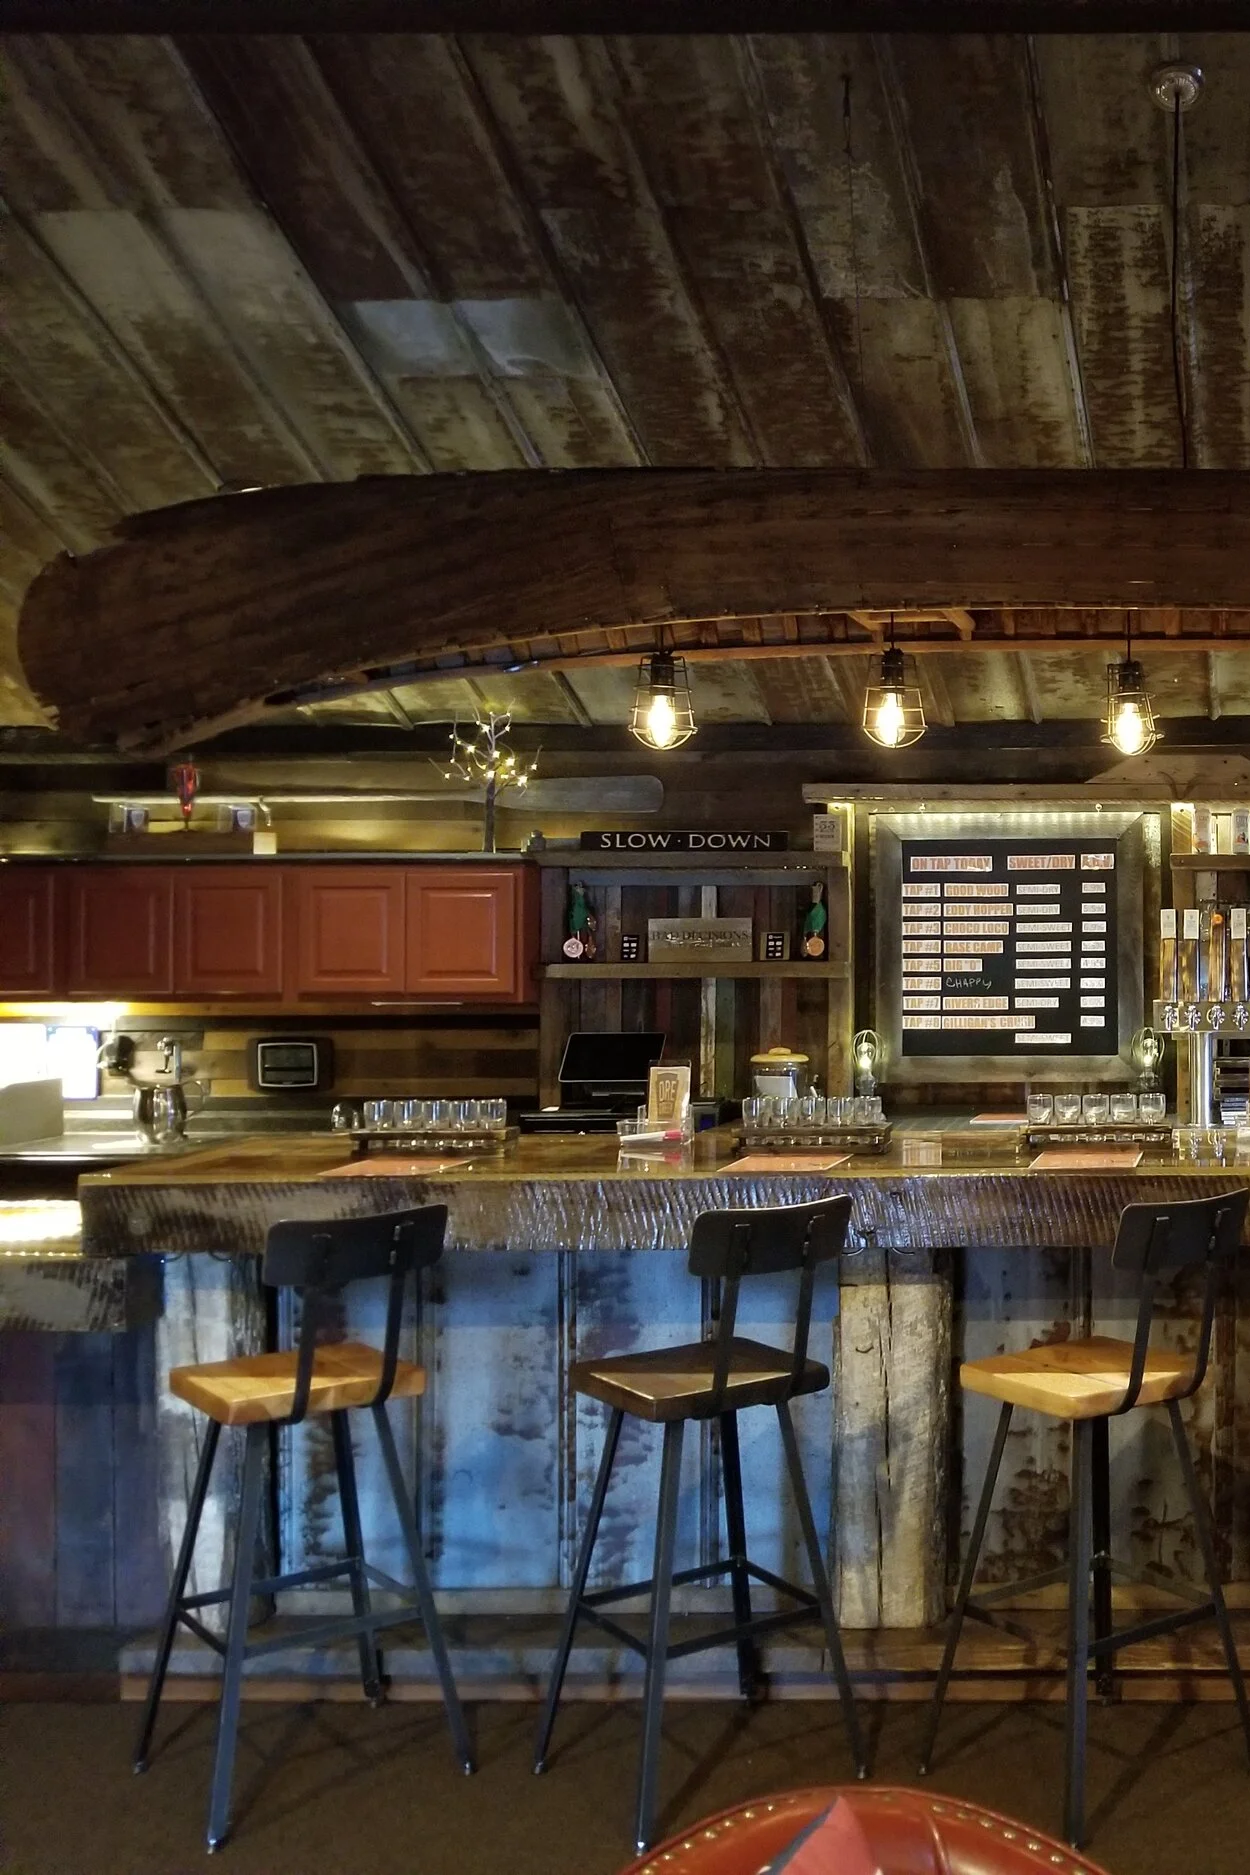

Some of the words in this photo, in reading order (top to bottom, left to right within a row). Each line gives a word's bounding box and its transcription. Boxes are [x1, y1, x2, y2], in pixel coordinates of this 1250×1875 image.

[600, 833, 671, 848] SLOW
[689, 834, 771, 848] DOWN
[912, 858, 928, 870] ON
[931, 857, 951, 869] TAP
[955, 857, 990, 870] TODAY
[1009, 856, 1075, 868] SWEET/DRY
[904, 885, 922, 895] TAP
[925, 885, 940, 895] #1
[946, 885, 973, 895] GOOD
[976, 885, 1007, 895] WOOD
[904, 905, 922, 915] TAP
[925, 905, 940, 915] #2
[946, 905, 972, 915] EDDY
[974, 904, 1012, 915] HOPPER
[904, 923, 922, 933] TAP
[925, 923, 940, 933] #3
[945, 923, 979, 933] CHOCO
[983, 923, 1008, 933] LOCO
[904, 941, 922, 952] TAP
[925, 941, 940, 952] #4
[946, 942, 972, 952] BASE
[973, 942, 1002, 952] CAMP
[904, 960, 922, 970] TAP
[925, 960, 940, 970] #5
[945, 960, 963, 970] BIG
[904, 978, 922, 989] TAP
[925, 978, 940, 989] #6
[946, 977, 992, 990] CHAPPY
[904, 998, 922, 1008] TAP
[925, 998, 940, 1008] #7
[944, 998, 979, 1009] RIVERS
[983, 997, 1008, 1008] EDGE
[904, 1017, 922, 1027] TAP
[925, 1017, 940, 1027] #8
[943, 1017, 996, 1028] GILLIGAN'S
[659, 1079, 677, 1101] ORE
